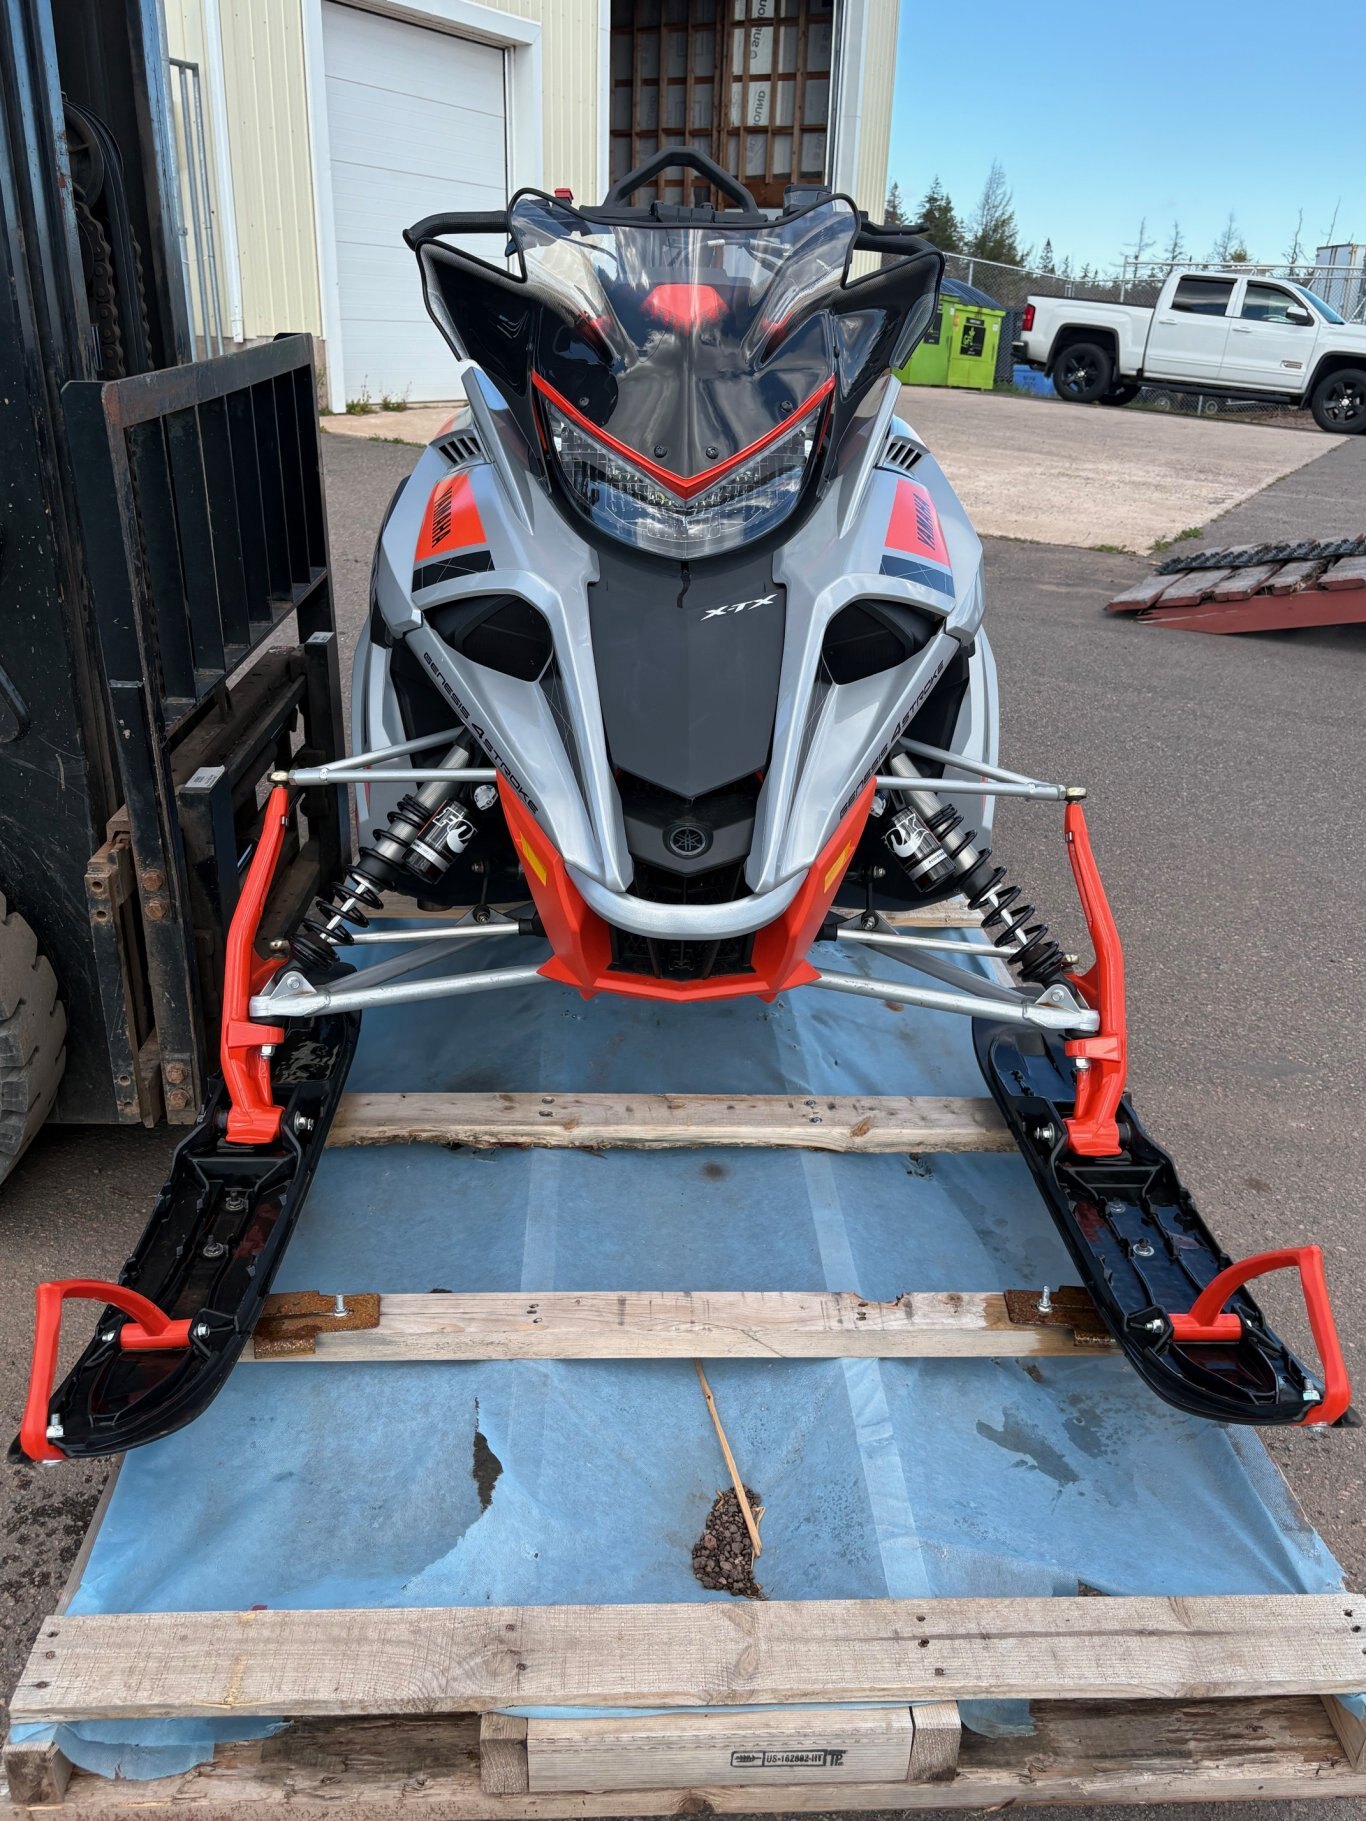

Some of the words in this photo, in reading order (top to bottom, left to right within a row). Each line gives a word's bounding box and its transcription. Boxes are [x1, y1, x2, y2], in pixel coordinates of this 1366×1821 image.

[431, 486, 453, 549] YAMAHA
[912, 492, 936, 551] YAMAHA
[423, 652, 471, 719] GENESIS
[839, 742, 889, 820] GENESIS
